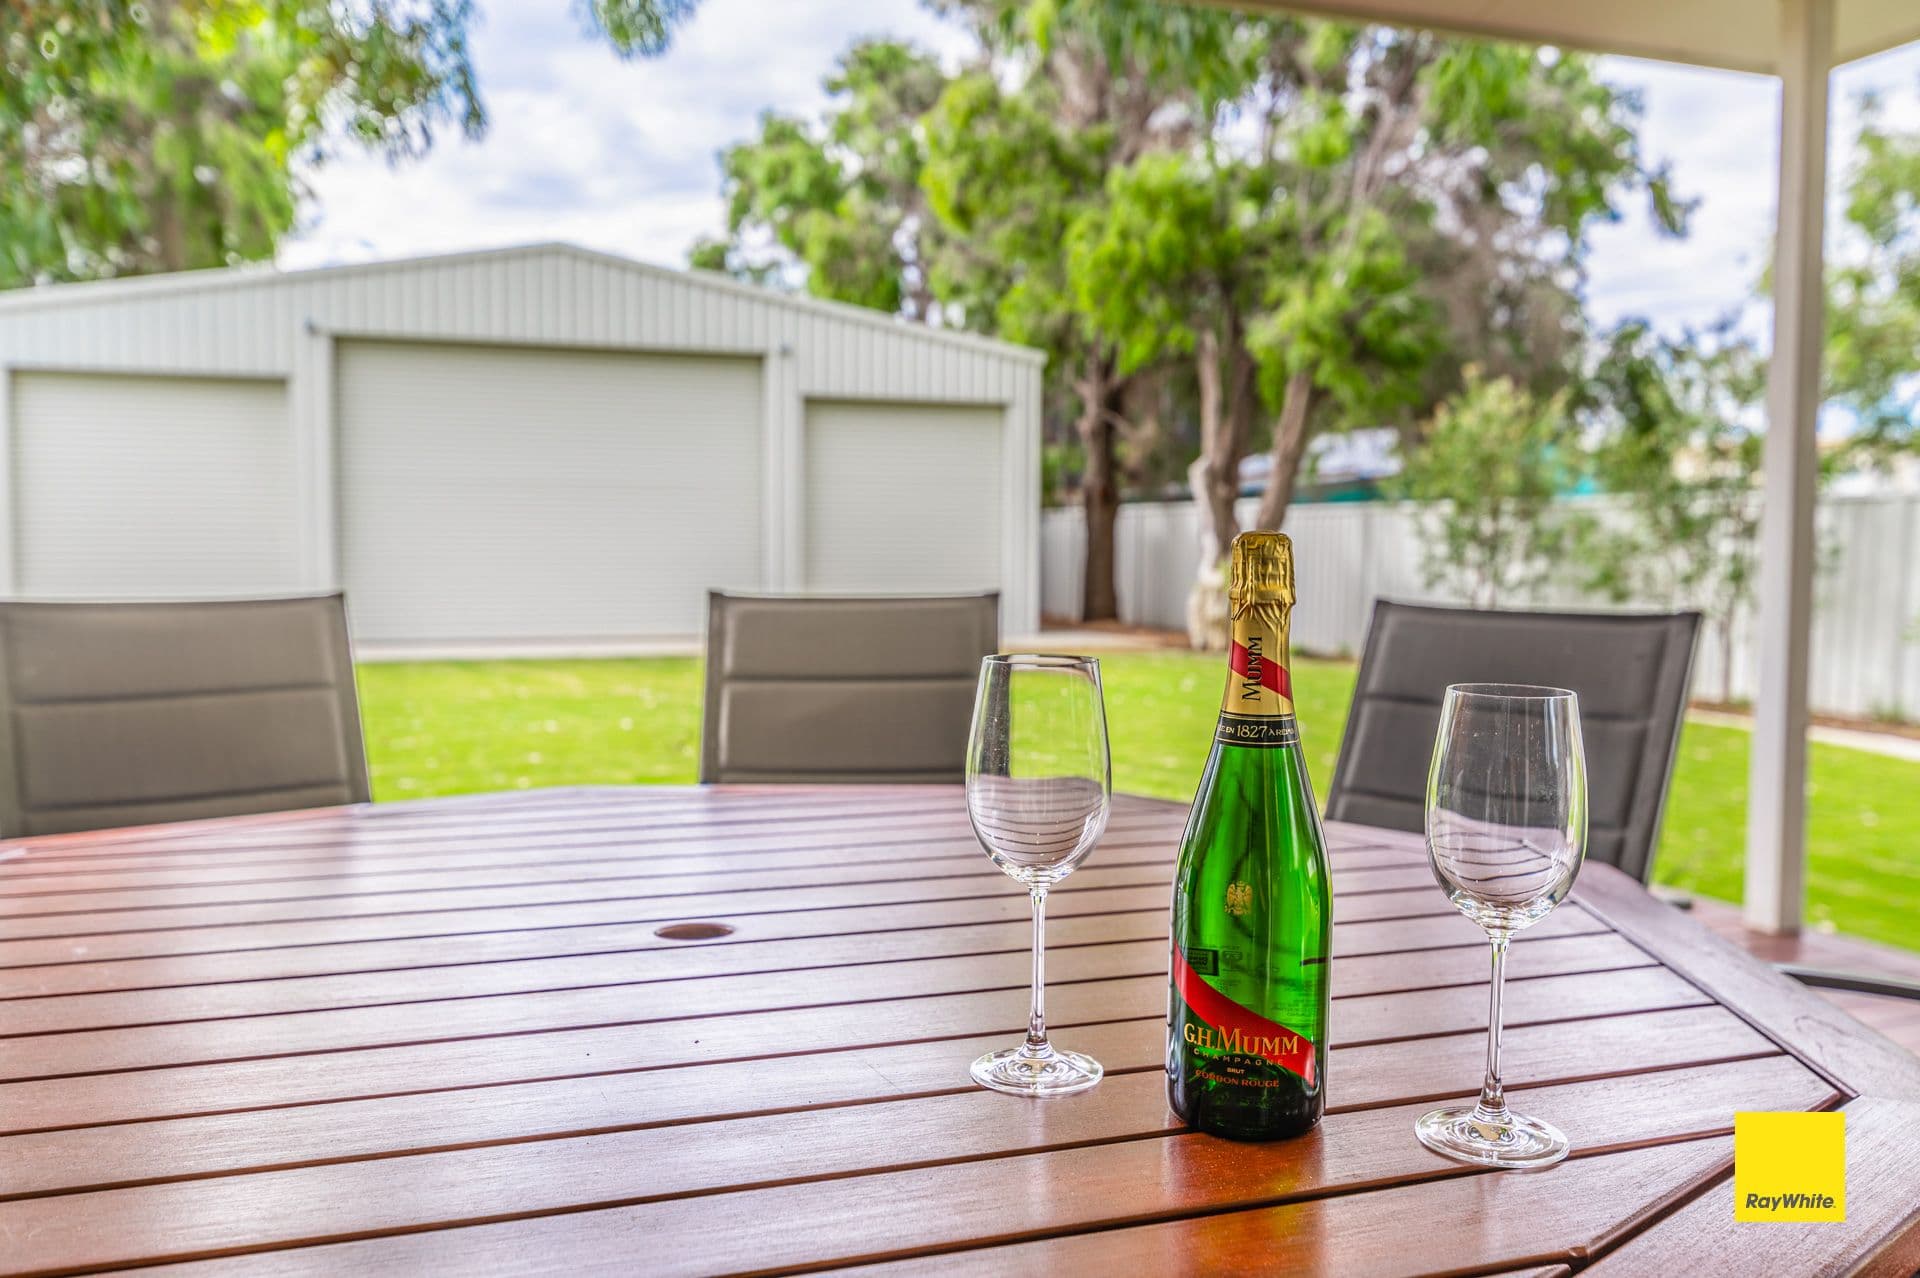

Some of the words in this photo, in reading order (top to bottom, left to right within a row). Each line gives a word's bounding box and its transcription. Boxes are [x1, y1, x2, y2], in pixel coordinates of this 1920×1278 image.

[1241, 636, 1263, 701] MUMM
[1237, 725, 1268, 738] 1827
[1217, 1025, 1299, 1056] MUMM
[1193, 1048, 1284, 1066] CHAMPAGNE
[1195, 1069, 1239, 1085] CORDON
[1241, 1079, 1280, 1088] ROUGE
[1226, 1067, 1245, 1075] BRUT
